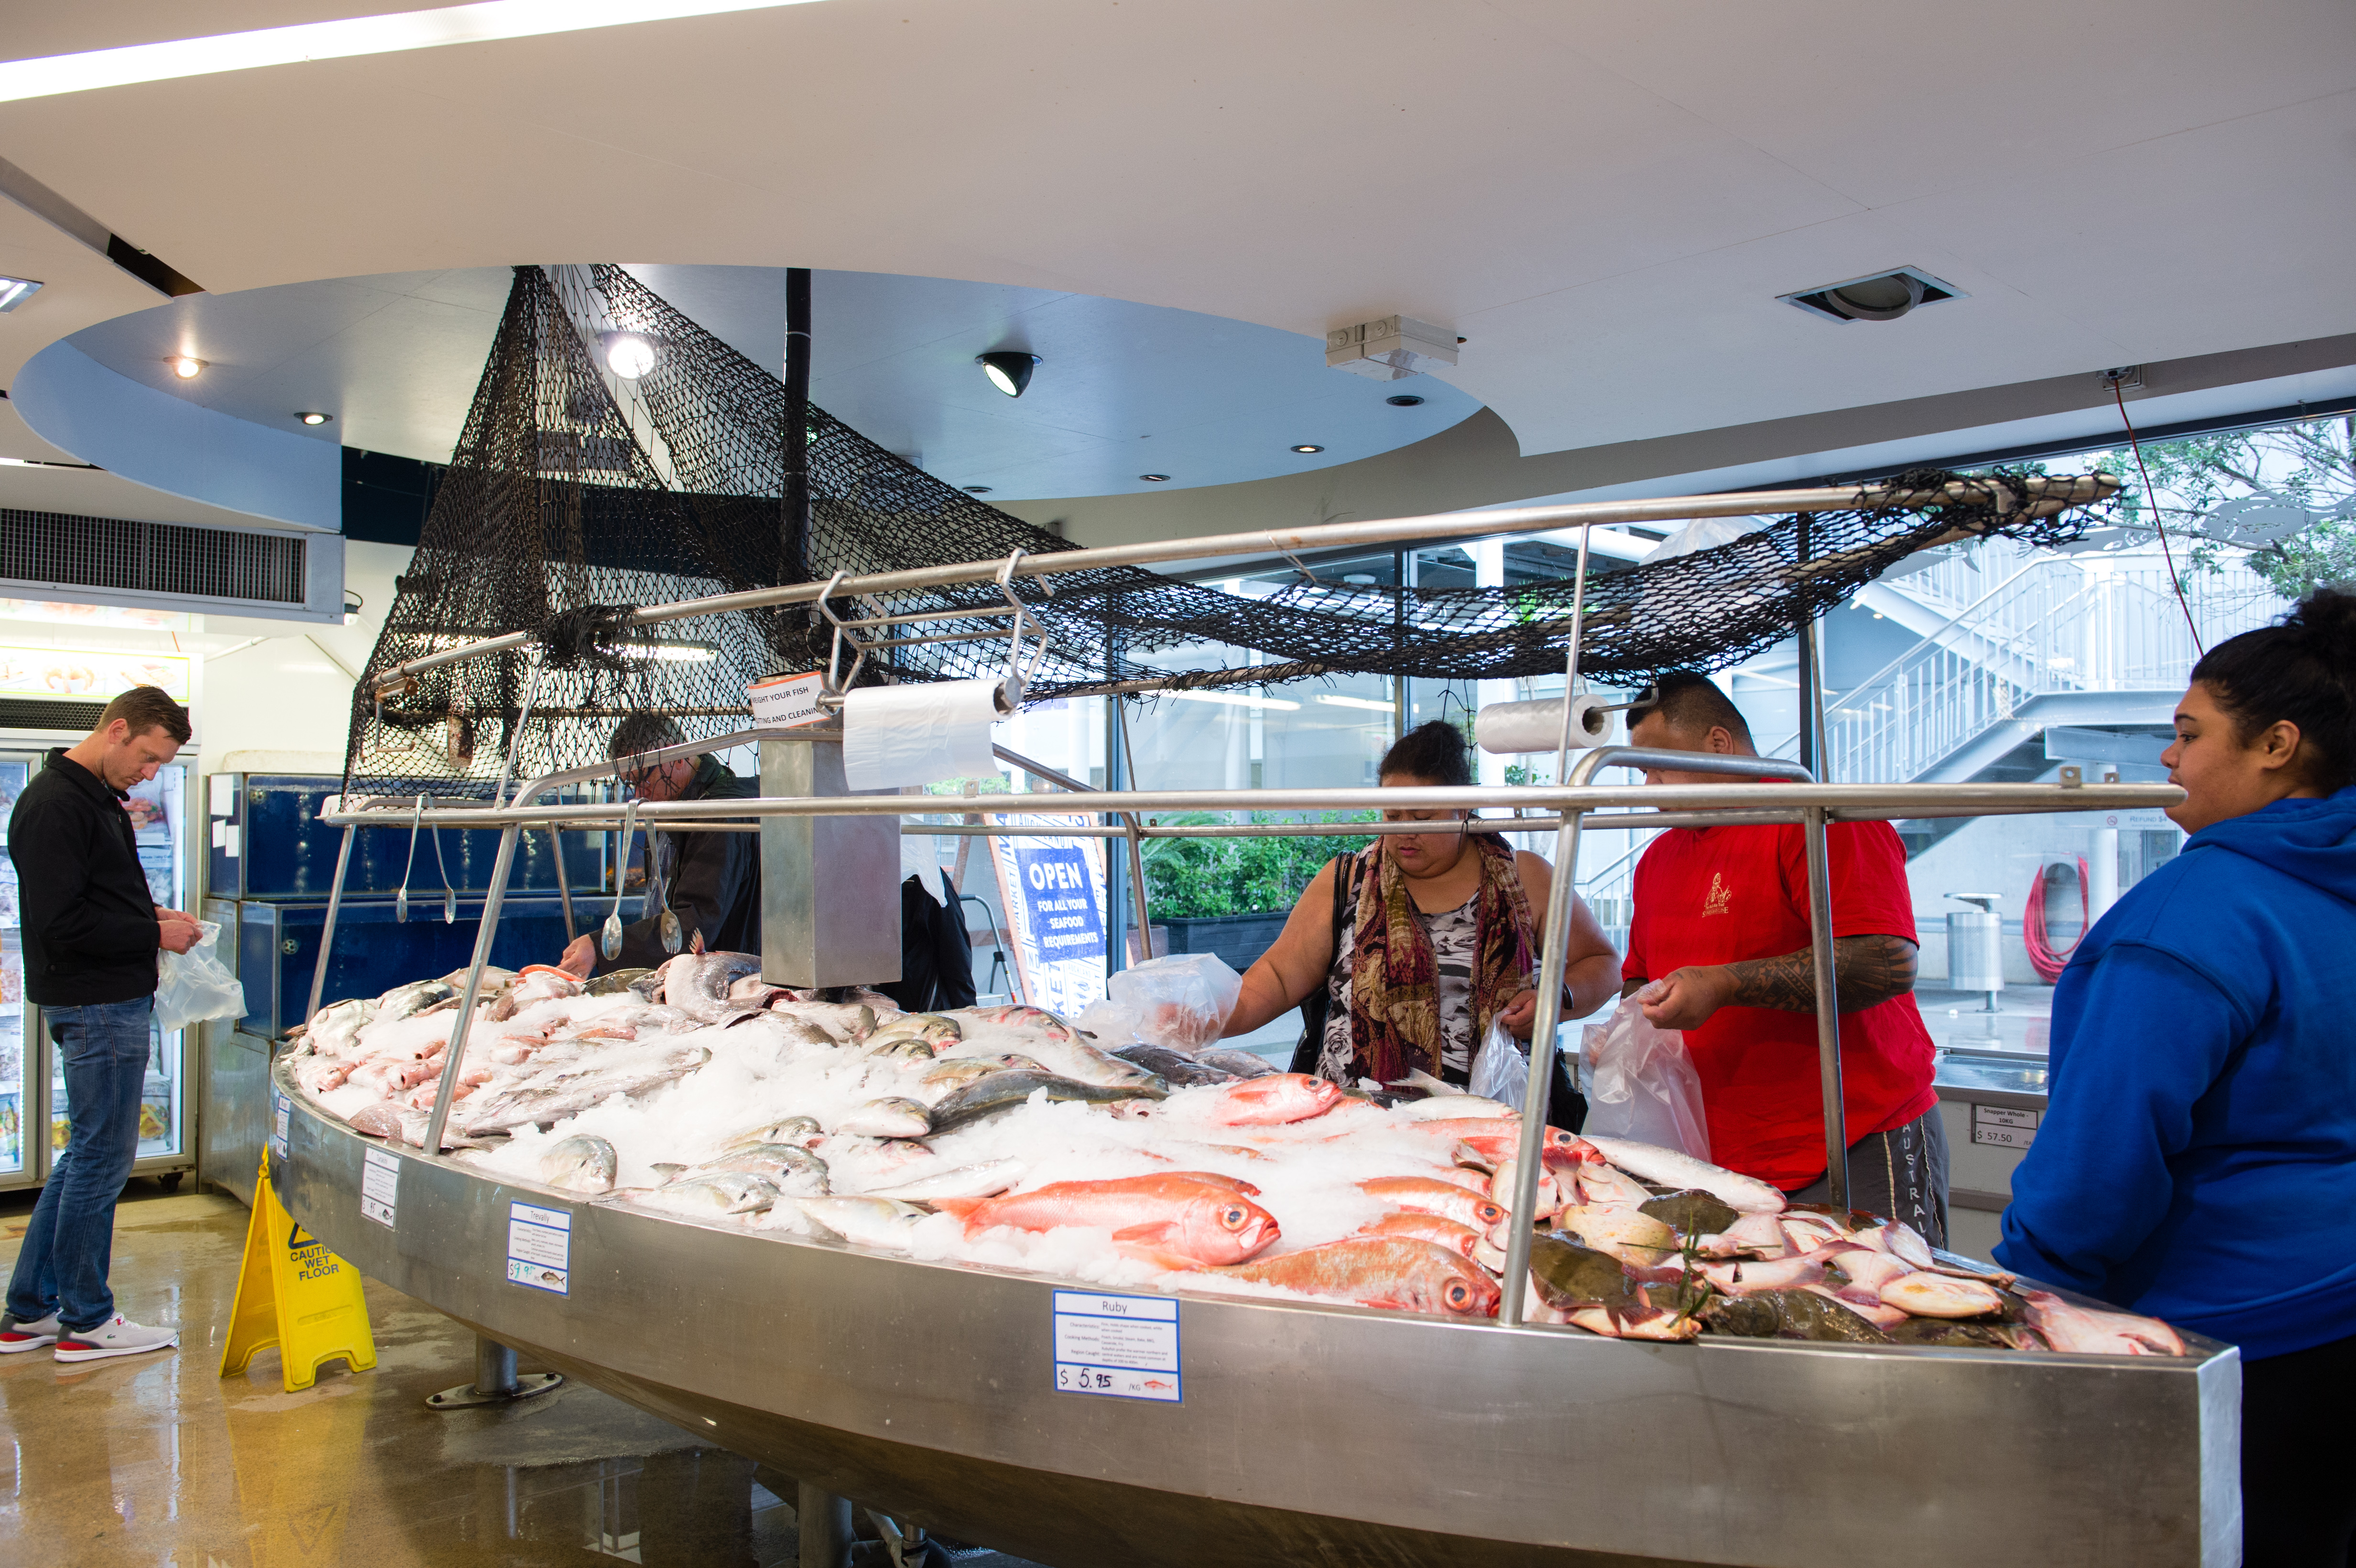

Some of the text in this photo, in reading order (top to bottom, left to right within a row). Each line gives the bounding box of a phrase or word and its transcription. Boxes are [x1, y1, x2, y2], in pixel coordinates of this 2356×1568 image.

[770, 691, 791, 701] YOUR
[793, 686, 809, 696] FISH
[772, 715, 787, 723] AND
[788, 707, 819, 719] CLEANIN
[1029, 862, 1083, 890] OPEN
[1037, 898, 1088, 912] FOR ALL YOUR
[1049, 915, 1084, 929] SEAFOOD
[1043, 932, 1099, 949] REQUIREMENTS
[1977, 1130, 2012, 1143] $ 57.50
[1902, 1123, 1927, 1233] AUSTRAL
[531, 1211, 550, 1223] Trevally
[290, 1246, 333, 1262] CAUTIO
[305, 1255, 330, 1268] WET
[299, 1264, 339, 1281] FLOOR
[1102, 1301, 1127, 1315] Ruby
[1128, 1383, 1141, 1392] /KG
